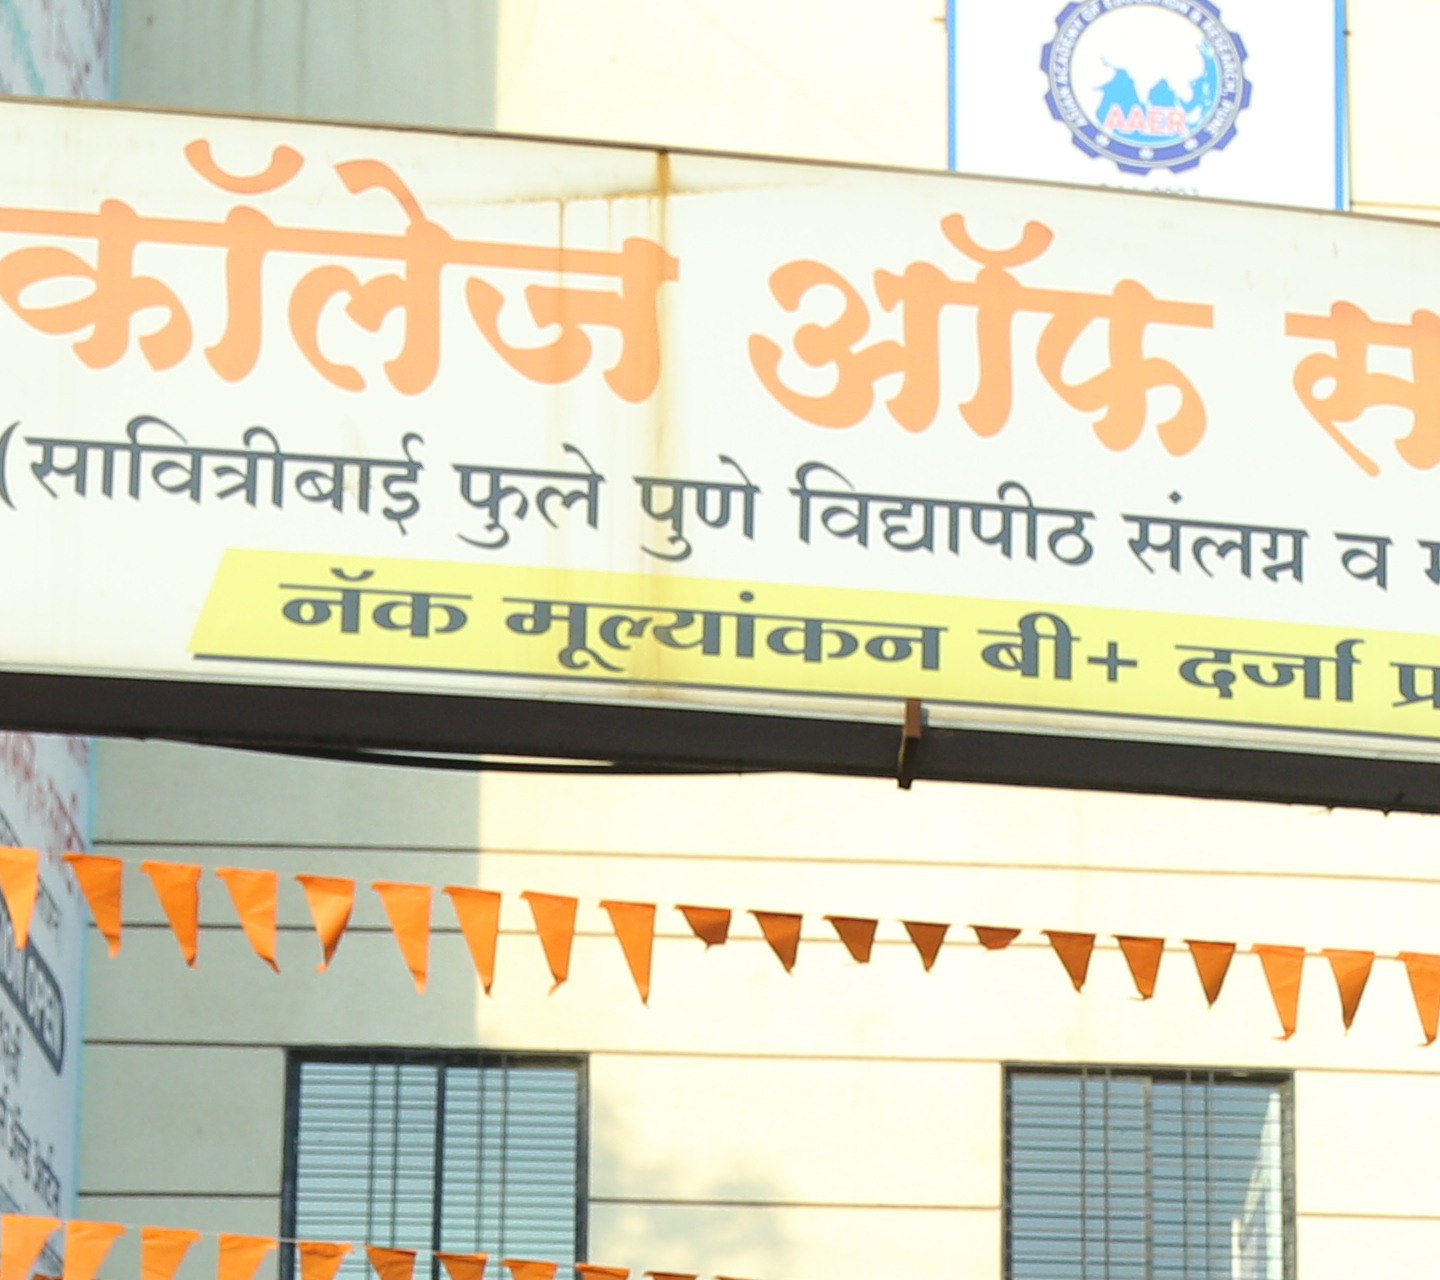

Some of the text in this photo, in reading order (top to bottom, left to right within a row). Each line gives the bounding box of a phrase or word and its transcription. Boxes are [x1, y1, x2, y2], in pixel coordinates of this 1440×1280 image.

[1103, 103, 1190, 135] AAER
[748, 213, 1214, 457] ऑफ
[453, 443, 605, 550] फुले
[633, 454, 760, 561] पुणे
[788, 461, 1095, 569] विद्यापीठ
[1122, 489, 1308, 584] संलग्न
[1336, 532, 1390, 590] व
[278, 566, 473, 639] नॅक
[503, 590, 948, 675] मूल्यांकन
[977, 610, 1139, 683] बी+
[1173, 637, 1364, 703] दर्जा
